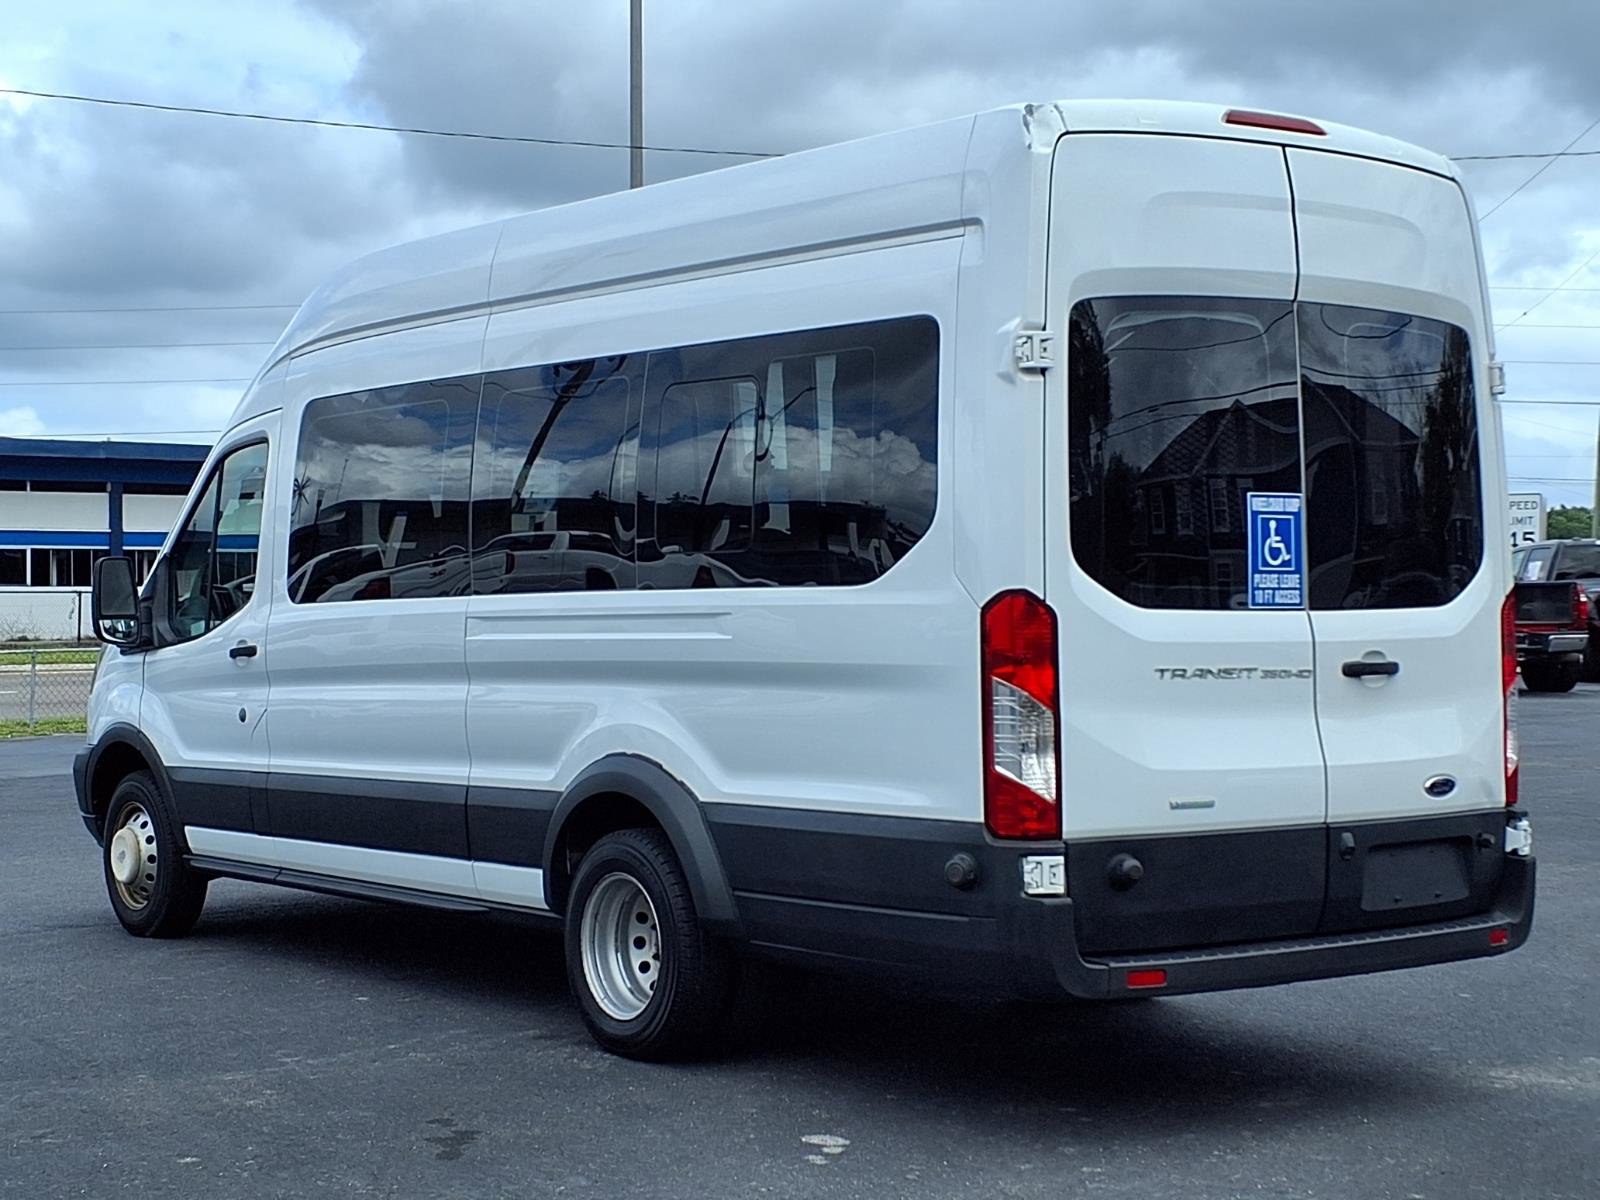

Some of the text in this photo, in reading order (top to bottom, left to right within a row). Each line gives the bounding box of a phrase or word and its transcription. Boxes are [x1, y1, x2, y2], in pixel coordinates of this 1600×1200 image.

[1509, 501, 1538, 510] PEED
[1510, 531, 1536, 548] 15
[1154, 667, 1258, 681] TRANSIT
